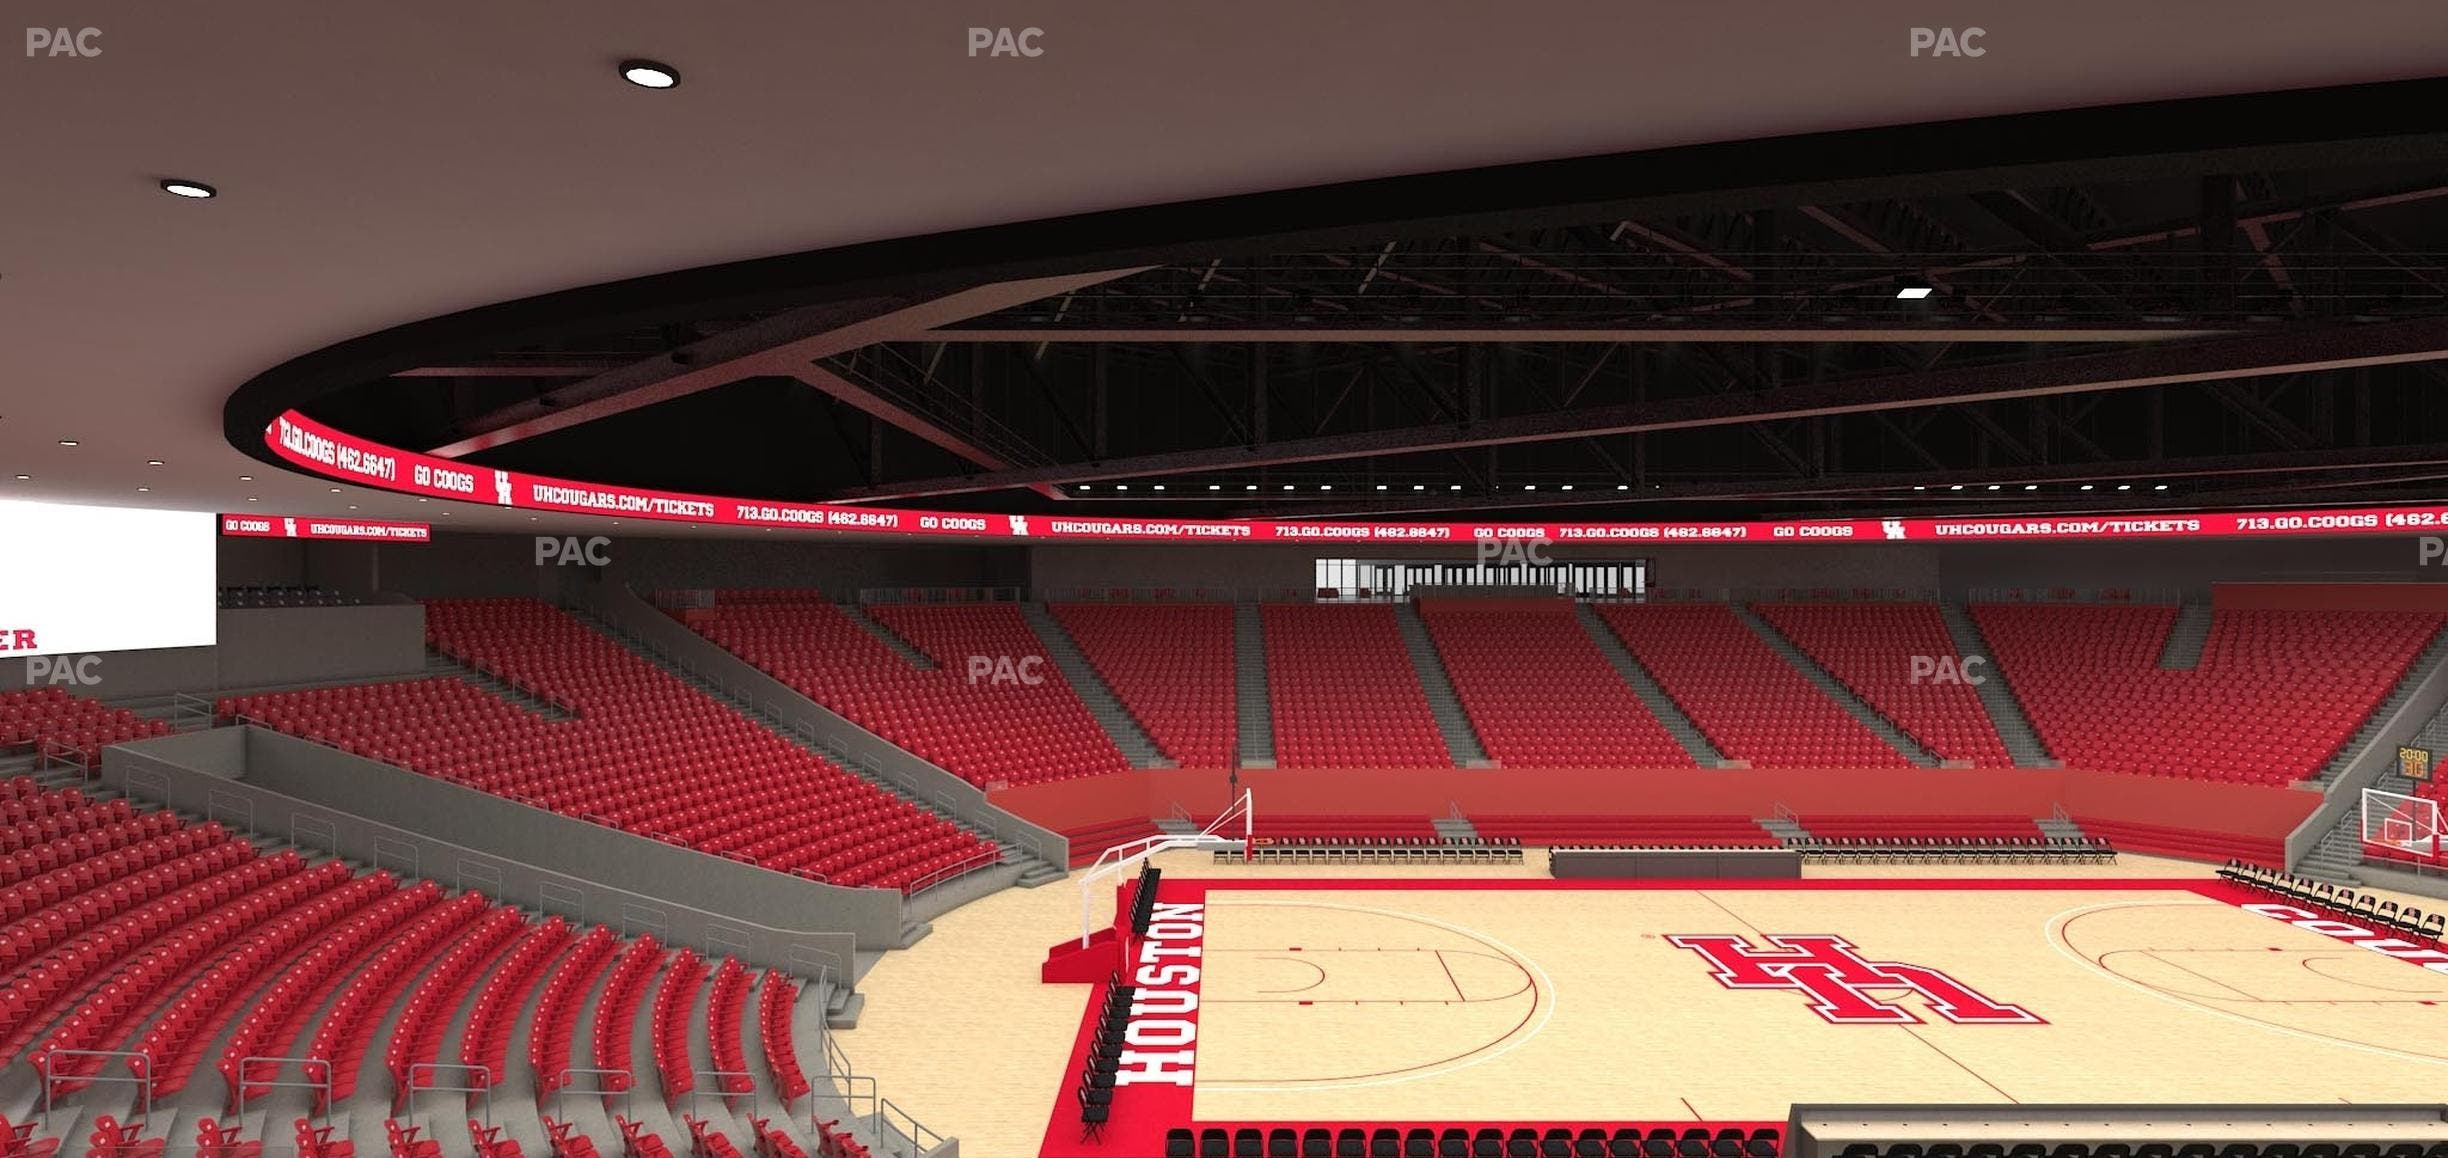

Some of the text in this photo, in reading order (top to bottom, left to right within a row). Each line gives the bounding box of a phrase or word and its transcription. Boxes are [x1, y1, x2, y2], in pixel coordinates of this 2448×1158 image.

[414, 463, 474, 494] GO COOGS
[532, 485, 714, 518] UHCOUGARS.COM/TICKETS
[736, 505, 824, 524] 713.GO.COOGS
[2236, 514, 2378, 530] 713.GO.COOGS
[919, 516, 987, 531] GO COOGS
[1051, 521, 1251, 538] UHCOUGARS.COM/TICKETS
[1773, 525, 1854, 537] GO COOGS
[1934, 515, 2200, 536] UHCOUGARS.COM/TICKETS
[1275, 526, 1371, 538] 713.GO.COOGS
[1473, 527, 1546, 538] GO COOGS
[1559, 527, 1660, 538] 713.GO.COOGS
[2399, 748, 2428, 761] 20:00
[1115, 902, 1205, 1087] HOUSTON
